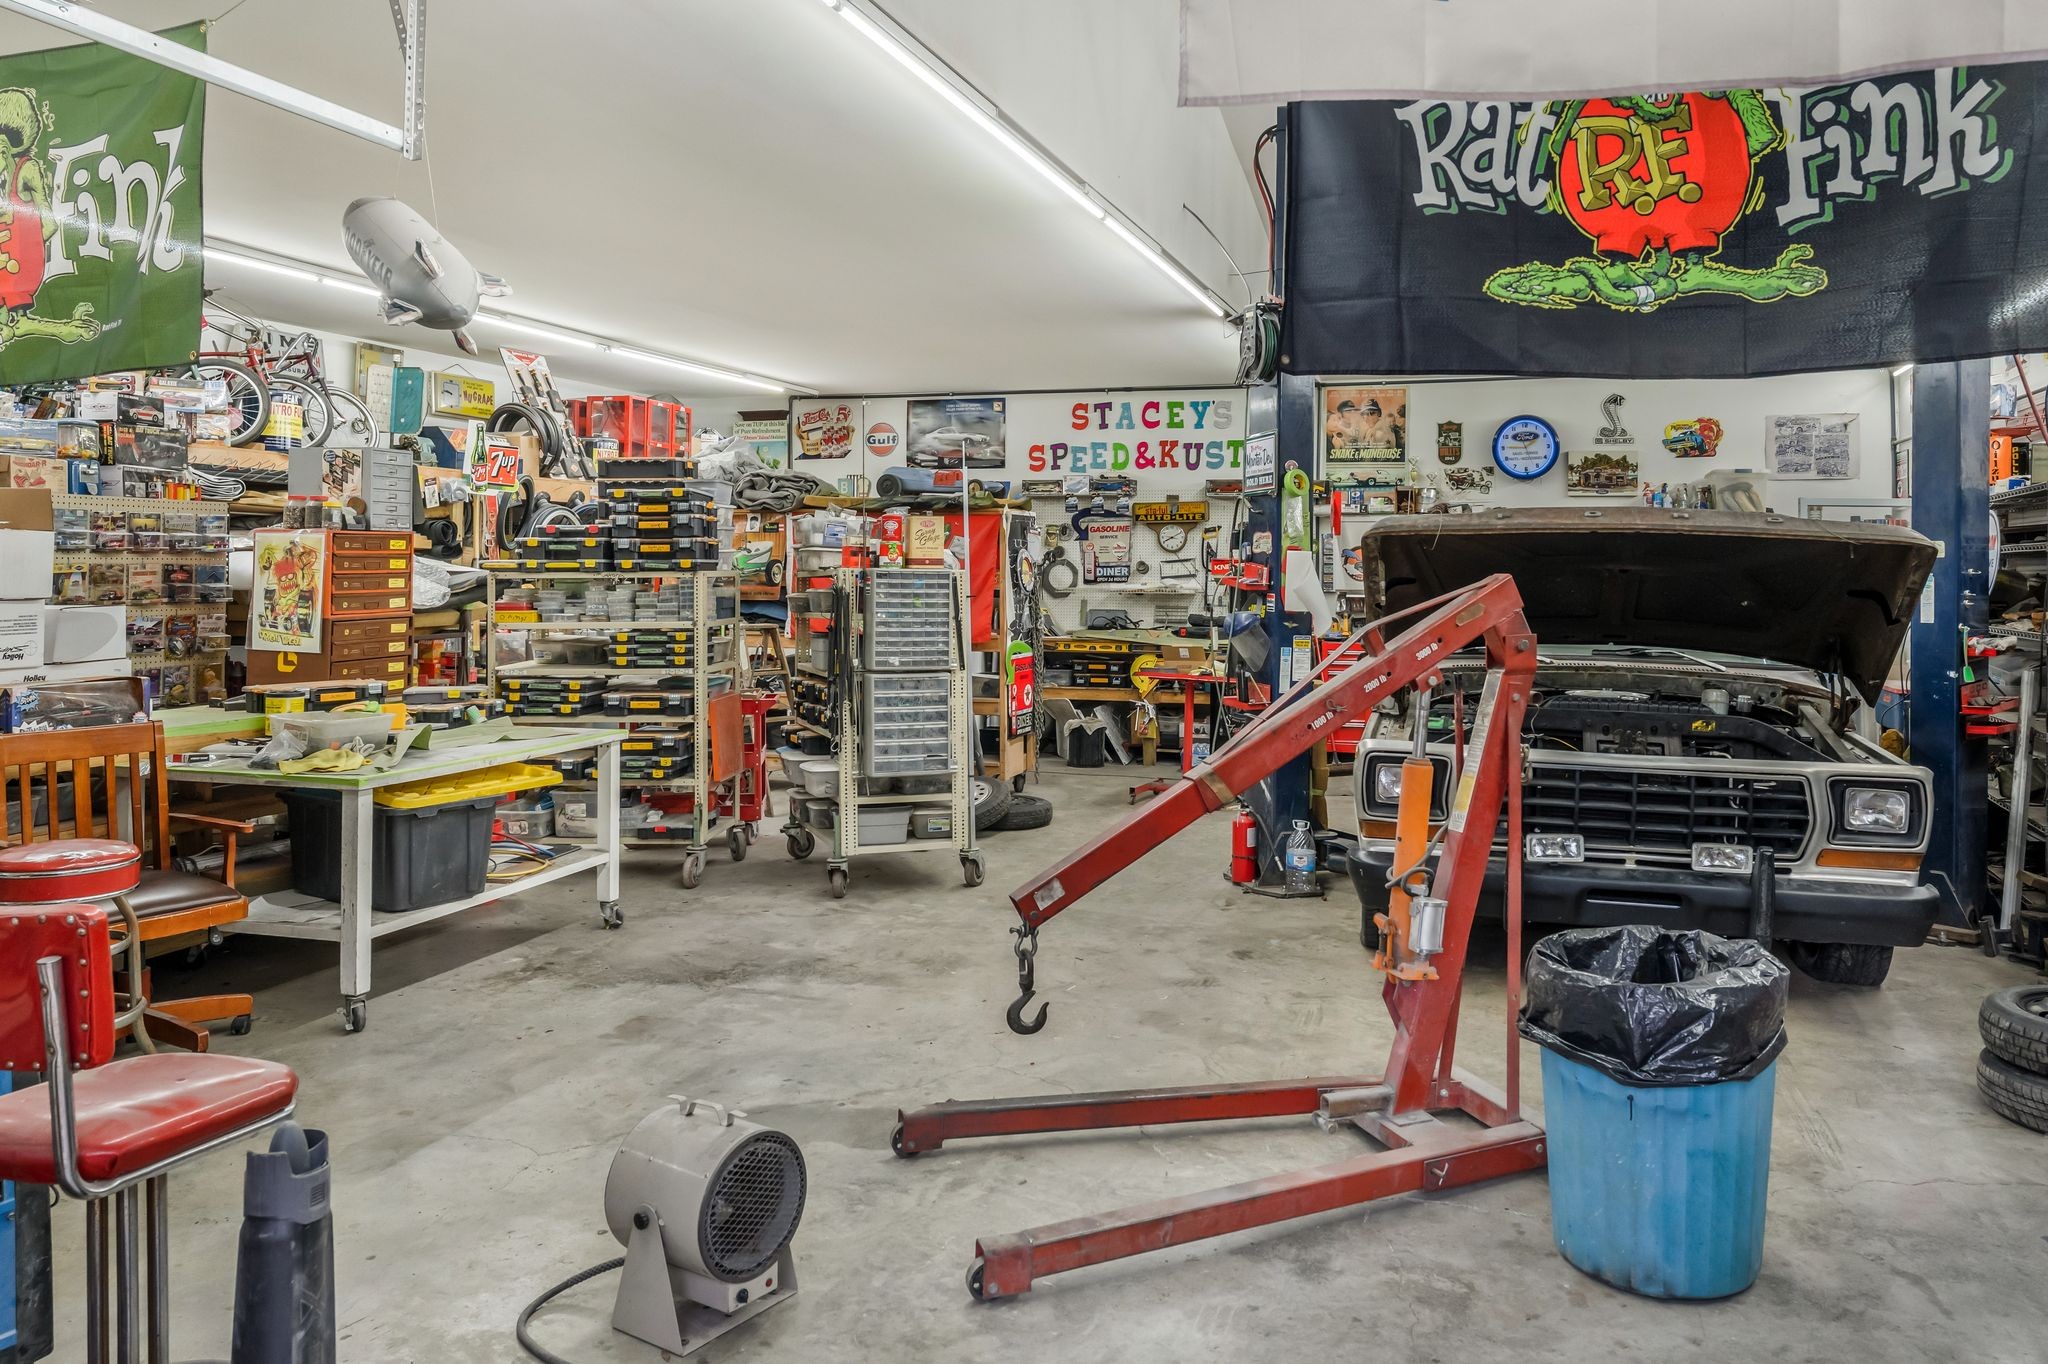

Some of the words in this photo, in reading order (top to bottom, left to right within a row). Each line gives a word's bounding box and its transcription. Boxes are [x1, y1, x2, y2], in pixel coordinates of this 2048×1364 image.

[1394, 101, 1555, 208] Rat
[1763, 67, 2000, 226] Fink
[44, 125, 187, 284] Fink
[272, 404, 292, 416] ITRO
[1071, 400, 1233, 430] STACEY'S
[867, 434, 897, 445] Gulf
[490, 450, 516, 478] 7up
[1991, 440, 2001, 486] Oilzu
[1096, 567, 1129, 576] DINER
[1415, 646, 1432, 661] 3000
[1431, 642, 1438, 651] lb
[23, 674, 47, 682] Holley
[1363, 678, 1380, 693] 2000
[1379, 673, 1387, 683] lb
[1311, 715, 1327, 731] 1000
[1326, 711, 1334, 720] lb
